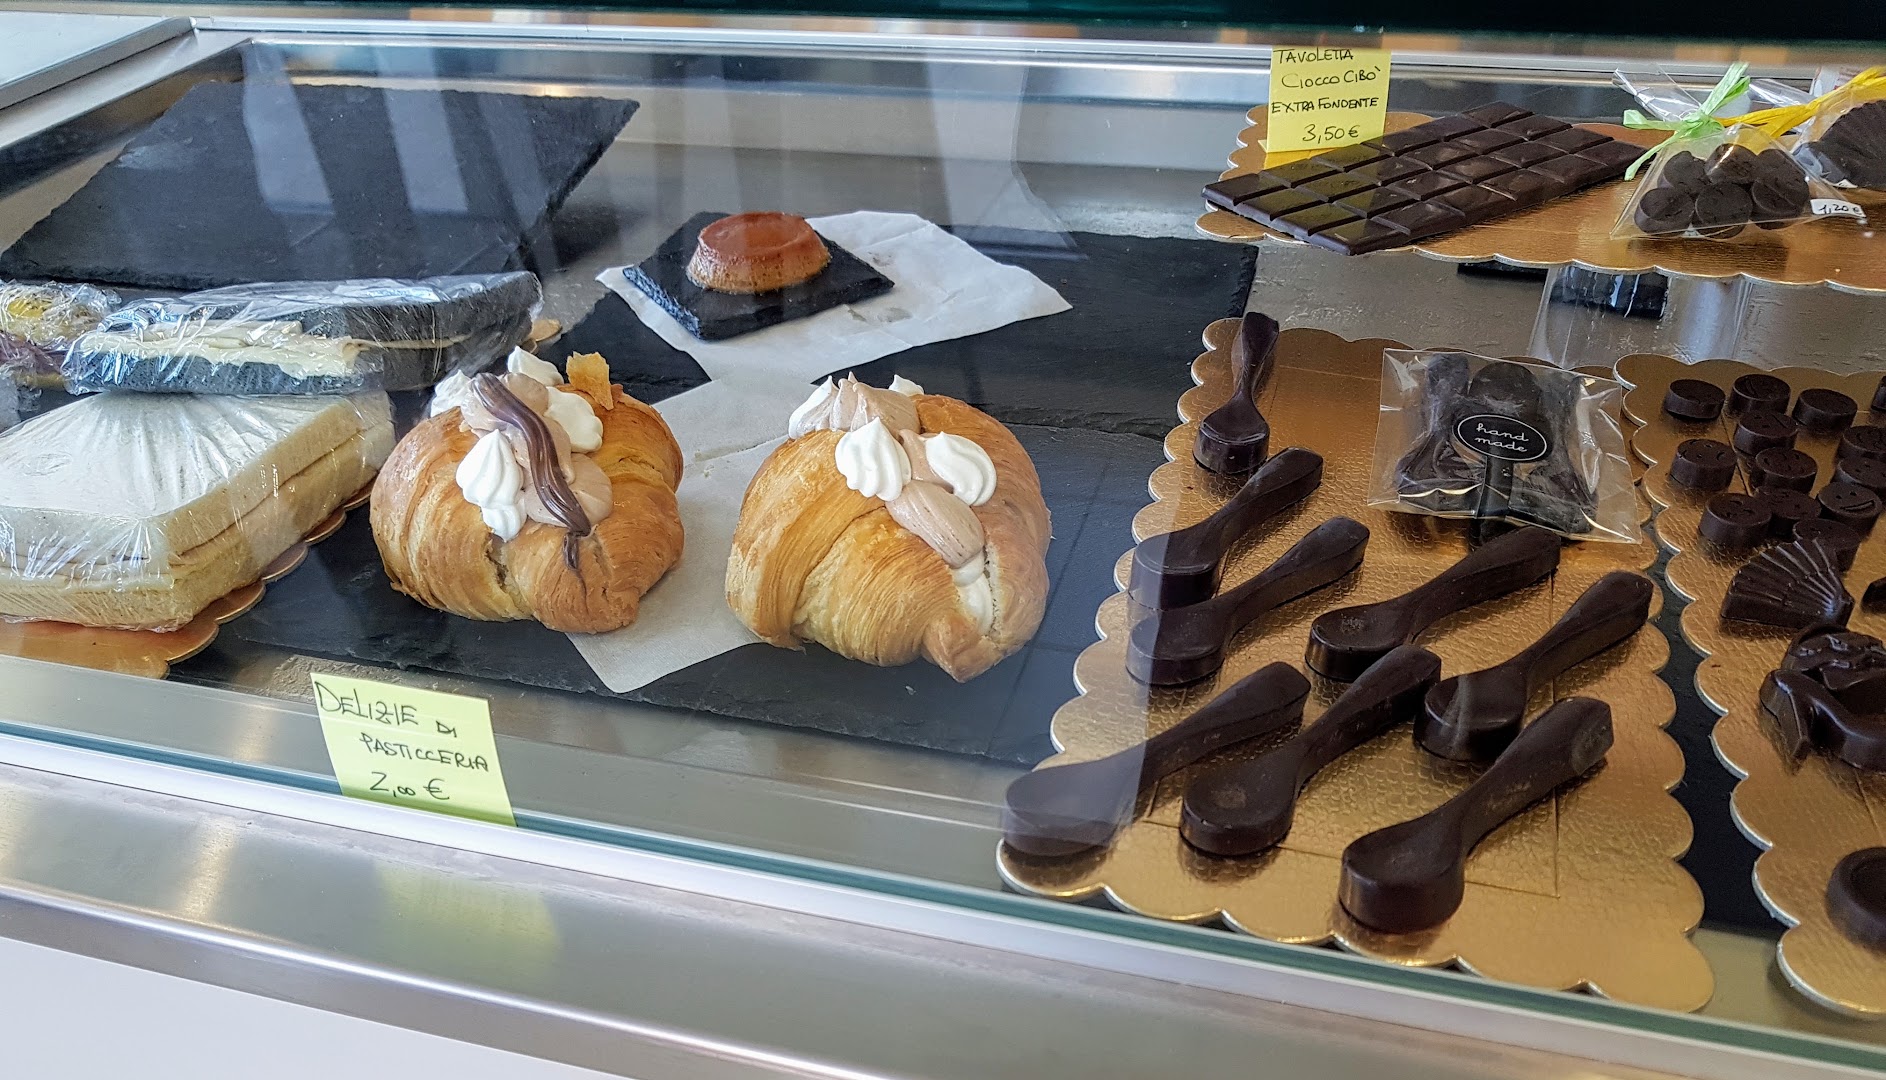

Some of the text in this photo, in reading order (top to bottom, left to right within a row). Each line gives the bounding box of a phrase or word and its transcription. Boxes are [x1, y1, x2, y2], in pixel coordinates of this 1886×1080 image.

[1273, 47, 1354, 64] TAVOLETTA
[1271, 97, 1379, 114] EXTRA FONDENTE
[1475, 422, 1529, 442] hand
[1474, 437, 1528, 452] made
[314, 680, 458, 738] DELIZIE DI
[359, 732, 489, 772] PASTICCERIA
